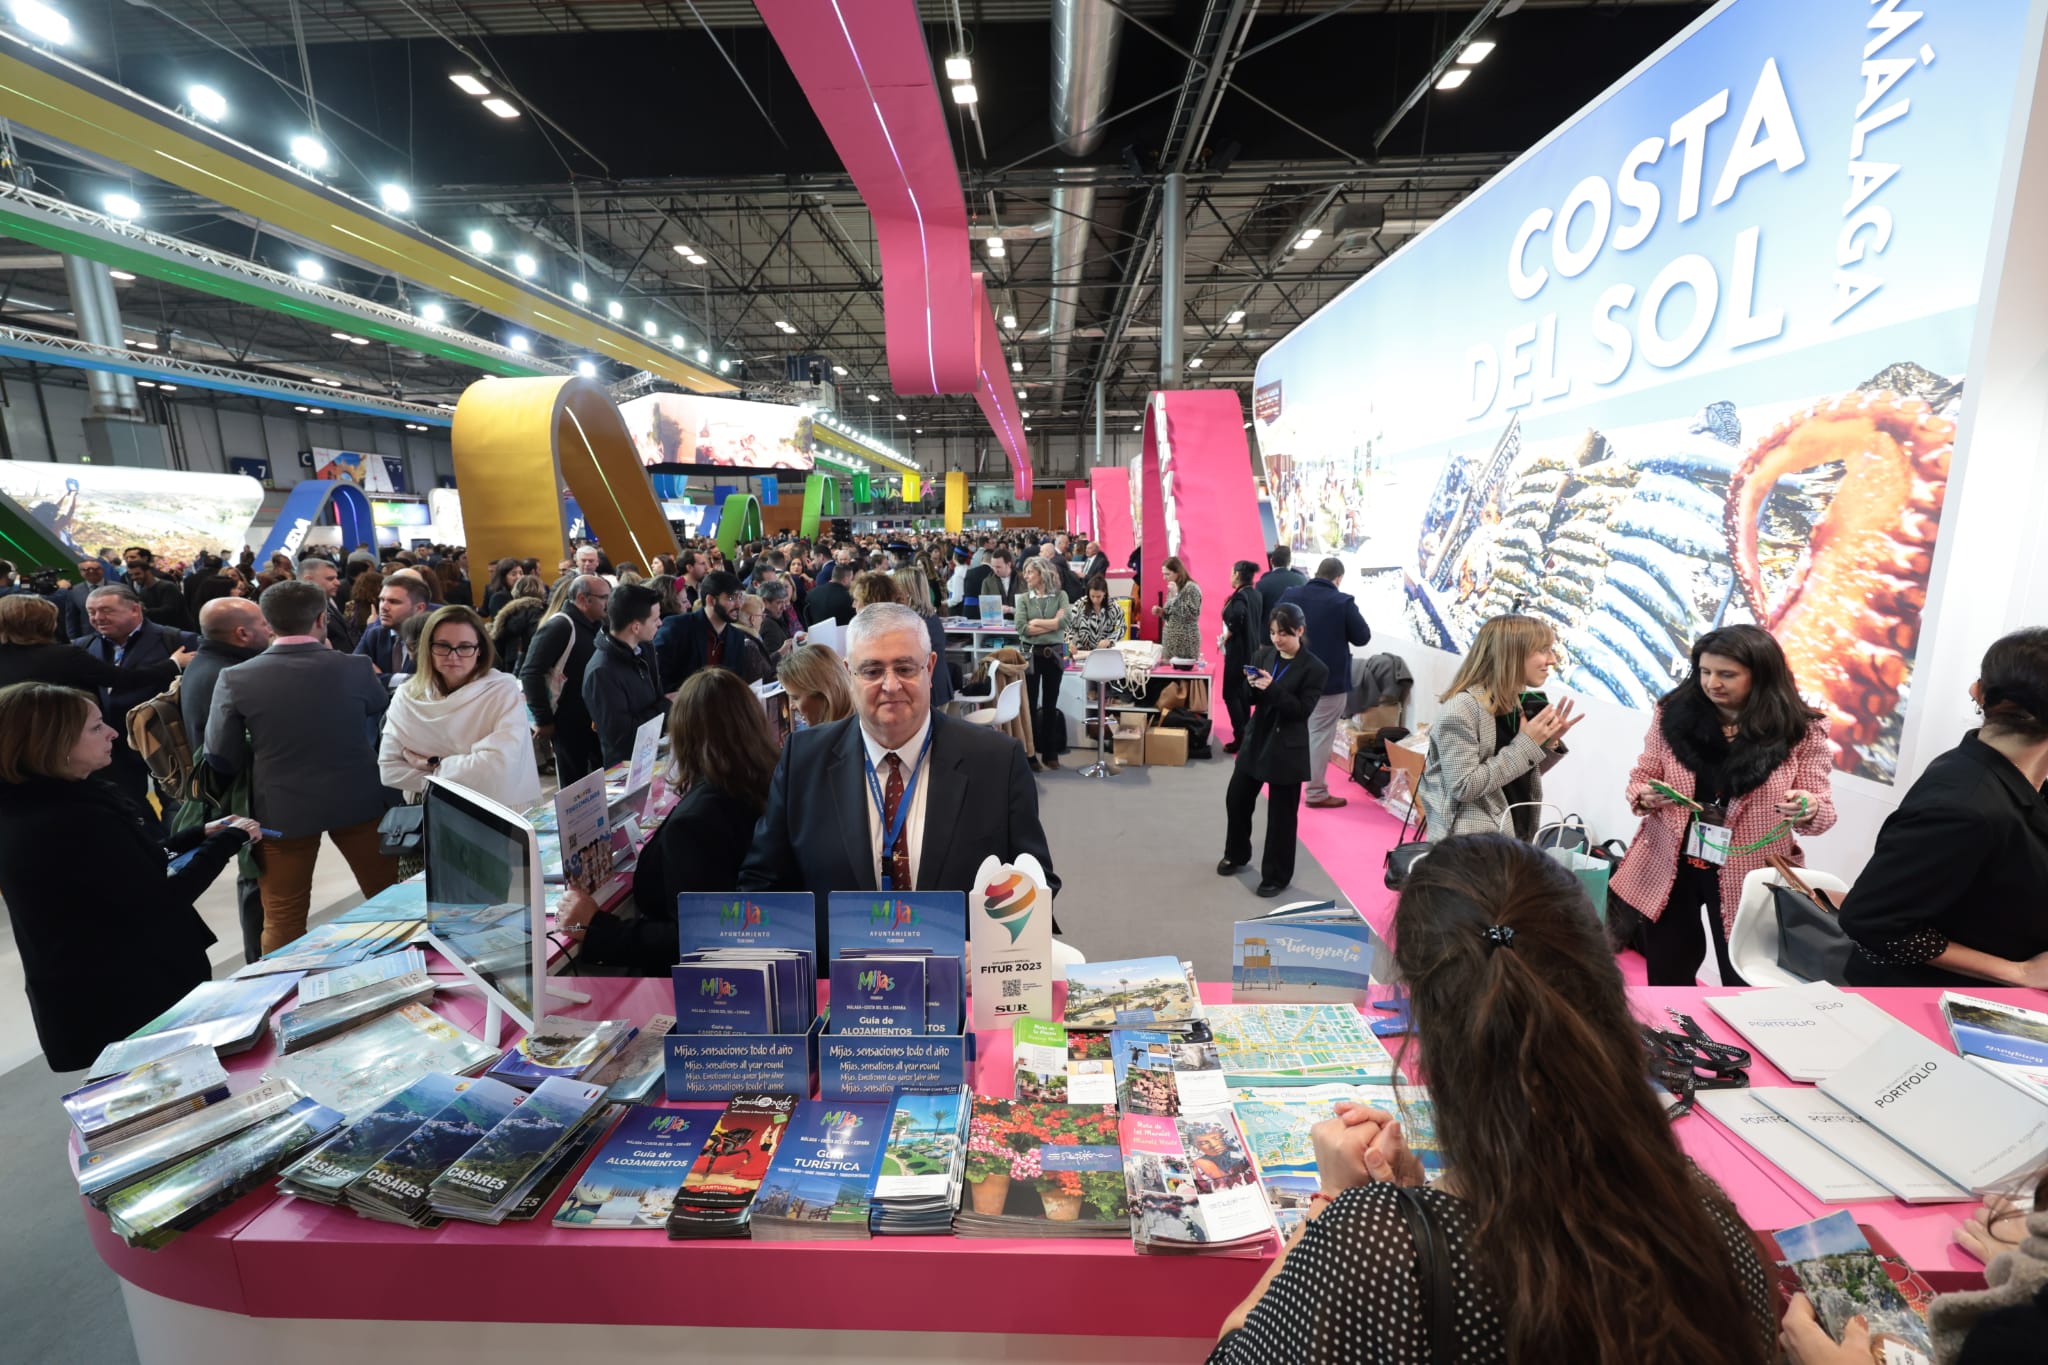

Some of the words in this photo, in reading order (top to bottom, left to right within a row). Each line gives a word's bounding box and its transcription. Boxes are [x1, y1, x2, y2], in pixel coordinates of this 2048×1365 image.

[1508, 57, 1806, 300] COSTA
[1465, 311, 1571, 422] DEL
[1591, 225, 1785, 384] SOL
[301, 453, 312, 466] C
[257, 465, 267, 478] 7
[720, 900, 771, 930] Mijas
[869, 899, 922, 930] Mijas
[980, 964, 1013, 974] FITUR
[1015, 962, 1042, 971] 2023
[700, 977, 738, 999] Mijas
[857, 969, 896, 994] Mijas
[995, 1003, 1028, 1013] SUR
[859, 1016, 880, 1025] Guía
[882, 1017, 893, 1025] de
[841, 1028, 912, 1036] ALOJAMIENTOS
[701, 1044, 748, 1056] sensaciones
[750, 1044, 768, 1055] todo
[769, 1043, 776, 1055] el
[777, 1044, 793, 1055] año
[856, 1044, 904, 1057] sensaciones
[907, 1044, 924, 1056] todo
[925, 1044, 933, 1056] el
[934, 1045, 950, 1056] año
[739, 1060, 747, 1069] all
[748, 1062, 762, 1071] year
[763, 1060, 784, 1069] round
[895, 1061, 903, 1070] all
[904, 1062, 918, 1073] year
[919, 1061, 940, 1070] round
[863, 1083, 894, 1093] sensatio
[1874, 1061, 1938, 1109] PORTFOLIO
[647, 1115, 691, 1134] Mijas
[820, 1110, 864, 1130] Mijas
[1740, 1114, 1789, 1124] PORTFO
[633, 1150, 656, 1158] Guía
[816, 1149, 844, 1159] Gu
[302, 1157, 356, 1180] CASARES
[605, 1157, 689, 1167] ALOJAMIENTOS
[794, 1158, 860, 1171] TURÍSTICA
[367, 1169, 425, 1199] CASARES
[446, 1167, 508, 1190] CASARES
